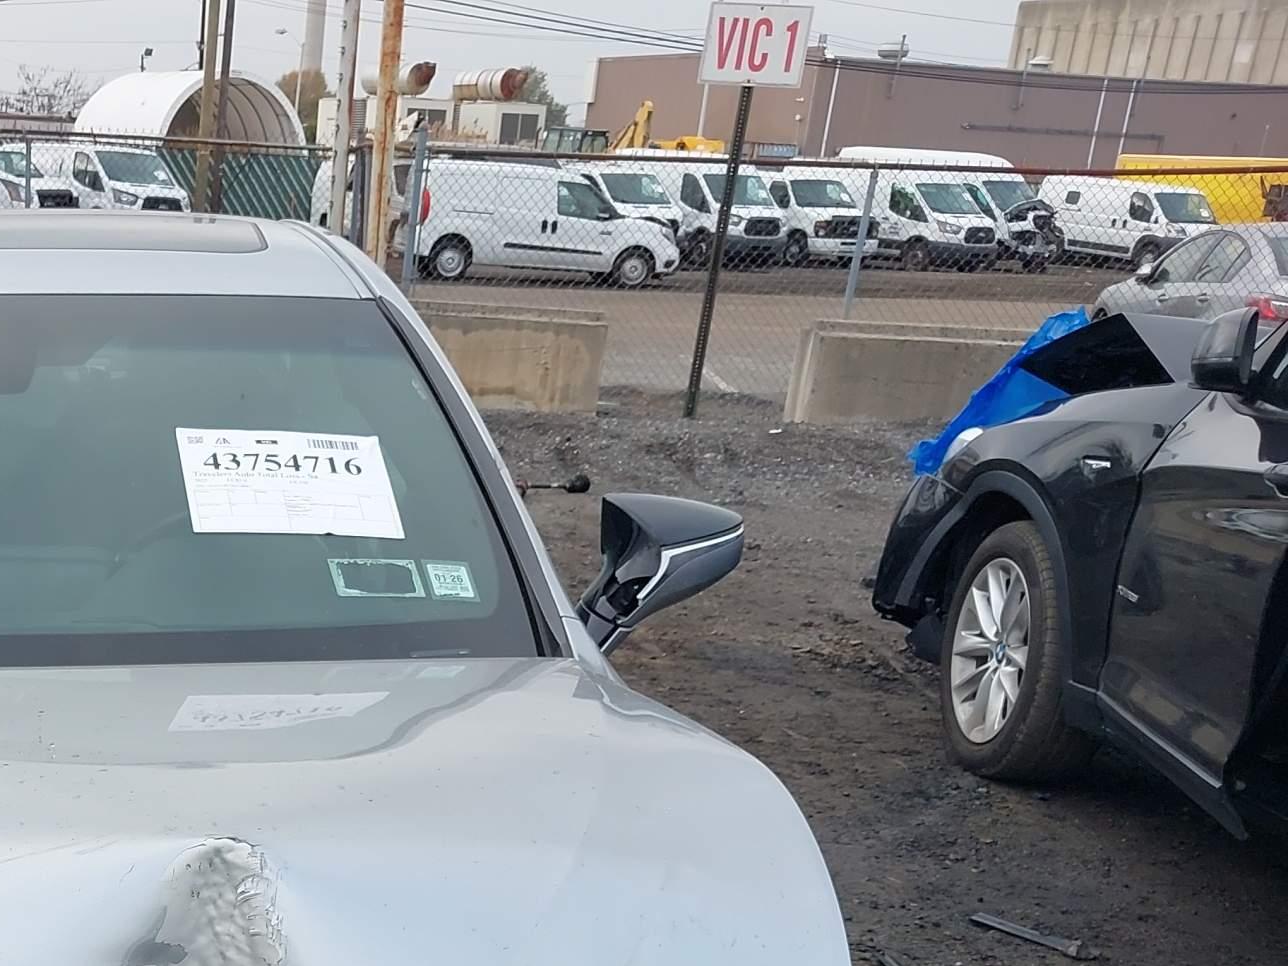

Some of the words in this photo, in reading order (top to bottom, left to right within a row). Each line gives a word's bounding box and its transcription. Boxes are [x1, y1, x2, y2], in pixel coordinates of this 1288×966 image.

[716, 16, 774, 73] VIC
[783, 20, 800, 73] 1
[202, 451, 363, 476] 43754716
